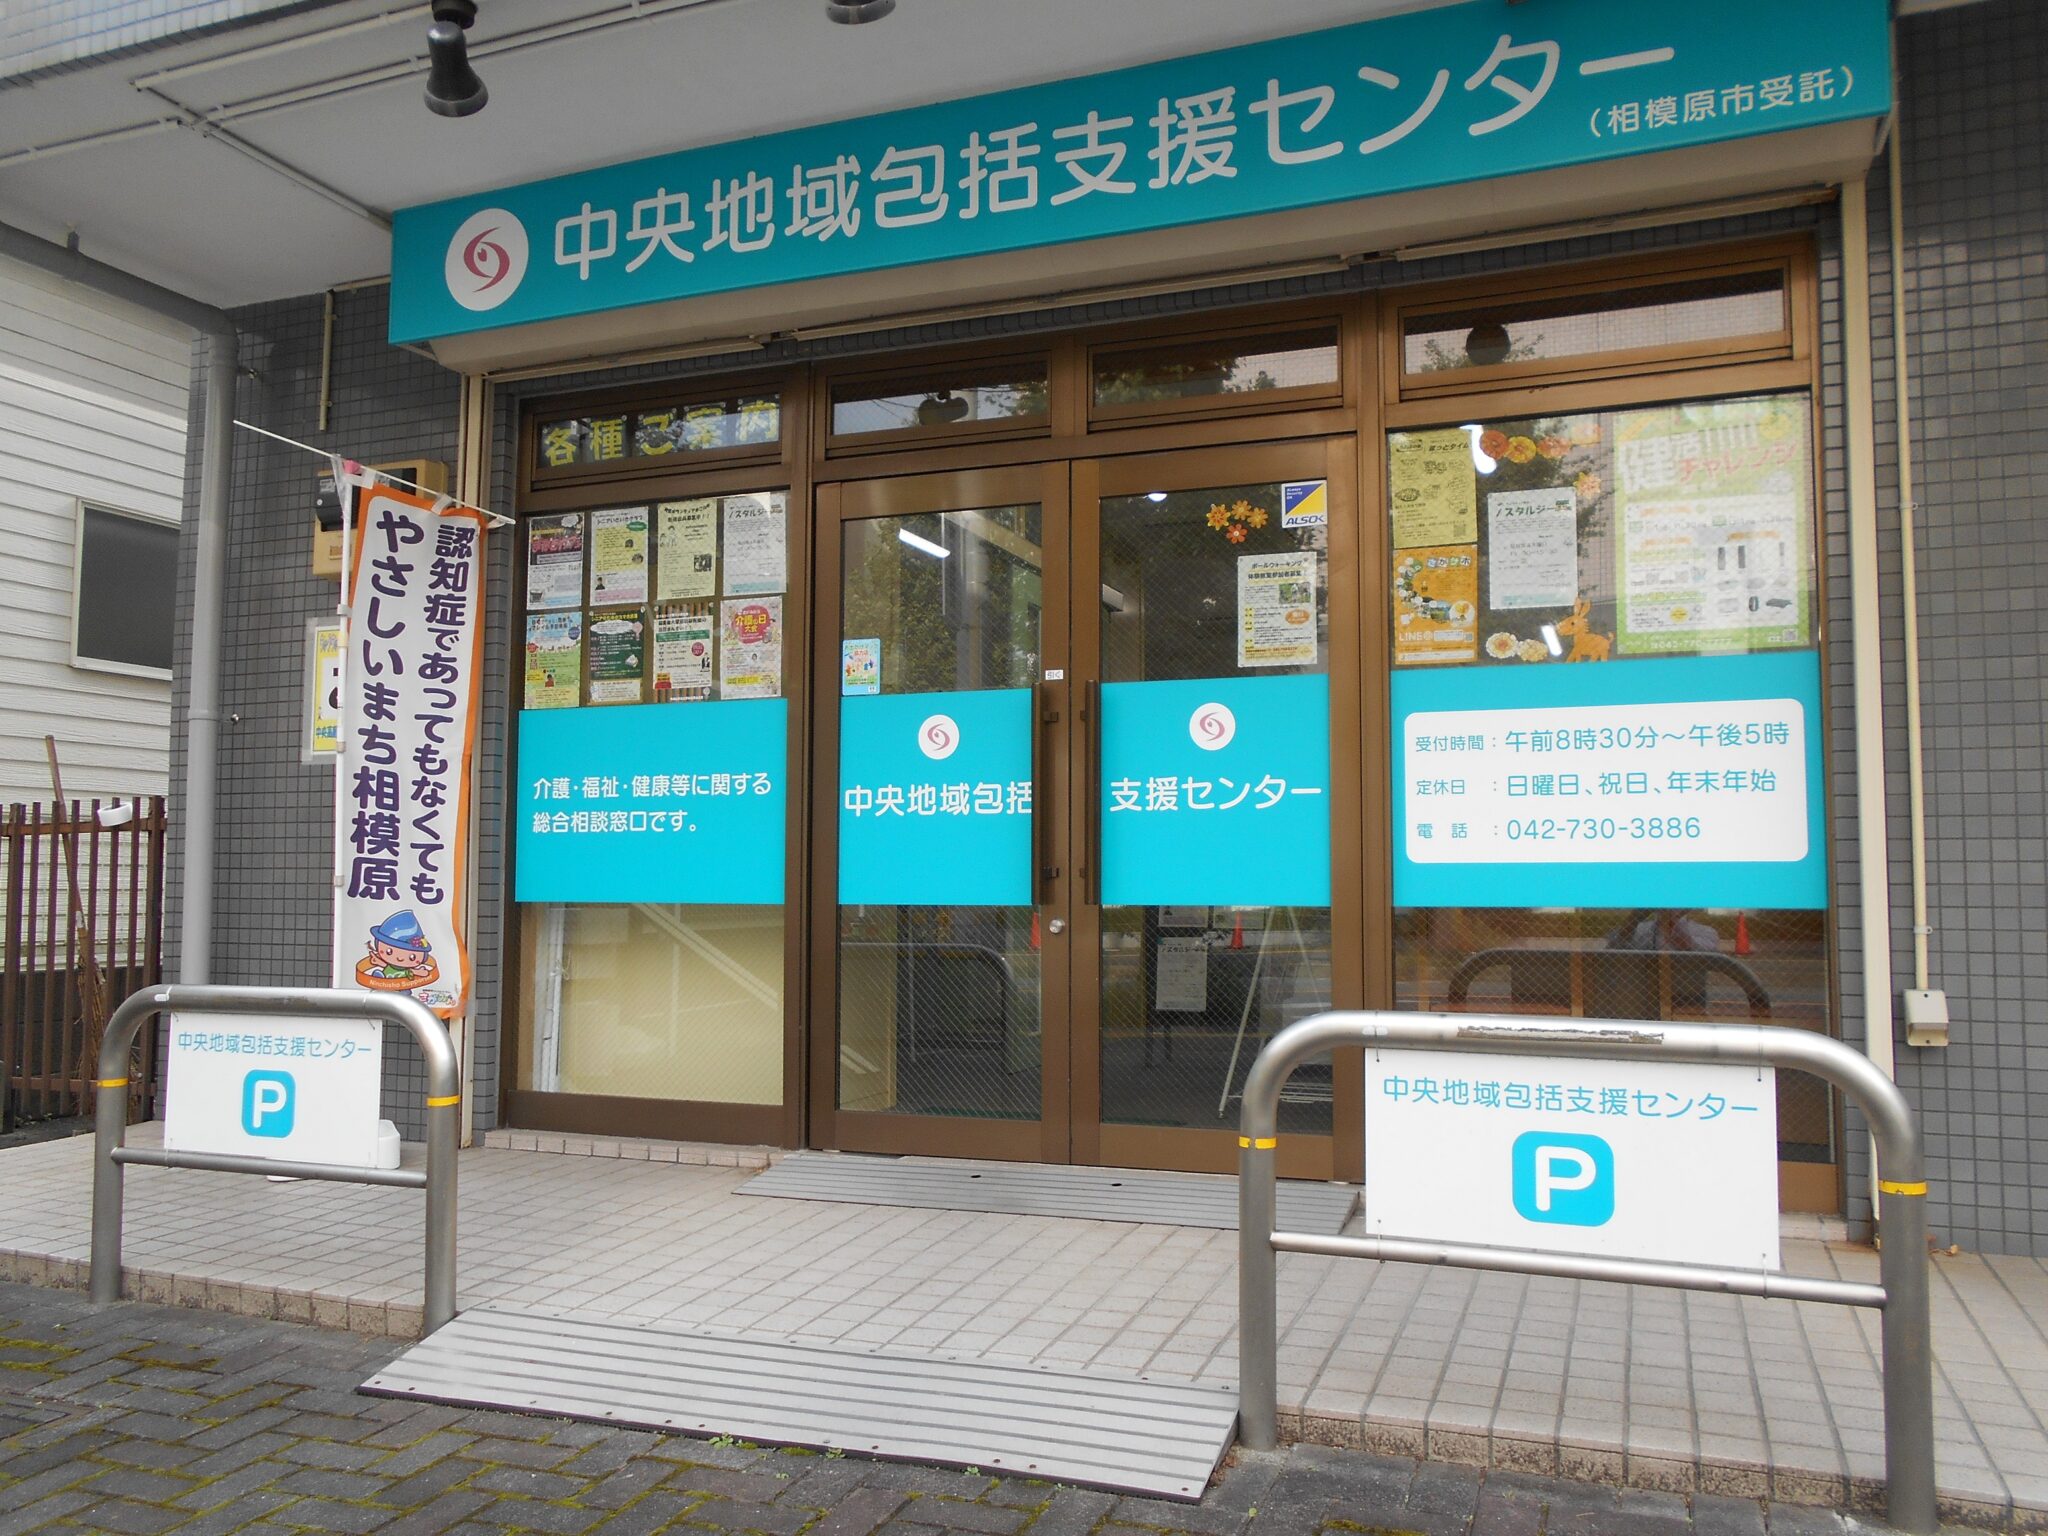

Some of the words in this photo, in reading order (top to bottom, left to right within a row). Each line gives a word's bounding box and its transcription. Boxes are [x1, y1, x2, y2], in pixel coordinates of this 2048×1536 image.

[554, 33, 1675, 280] 中央地域包括支援センター
[545, 400, 778, 467] 各種ご案内
[1285, 515, 1325, 526] ALSOK
[346, 510, 425, 901] やさしいまち相模原
[409, 523, 475, 905] 認知症であってもなくても
[533, 772, 772, 799] 介護・福祉・健康等に関する
[844, 780, 1033, 818] 中央地域包括
[1109, 774, 1322, 812] 支援センター
[1507, 768, 1777, 798] 日曜日、祝日、年末年始
[532, 810, 700, 834] 総合相談窓口です。
[1507, 816, 1702, 841] 042-730-3886
[177, 1031, 373, 1060] 中央地域包括支援センター
[251, 1079, 289, 1129] P
[1382, 1075, 1760, 1121] 中央地域包括支援センター
[1534, 1145, 1598, 1212] P
